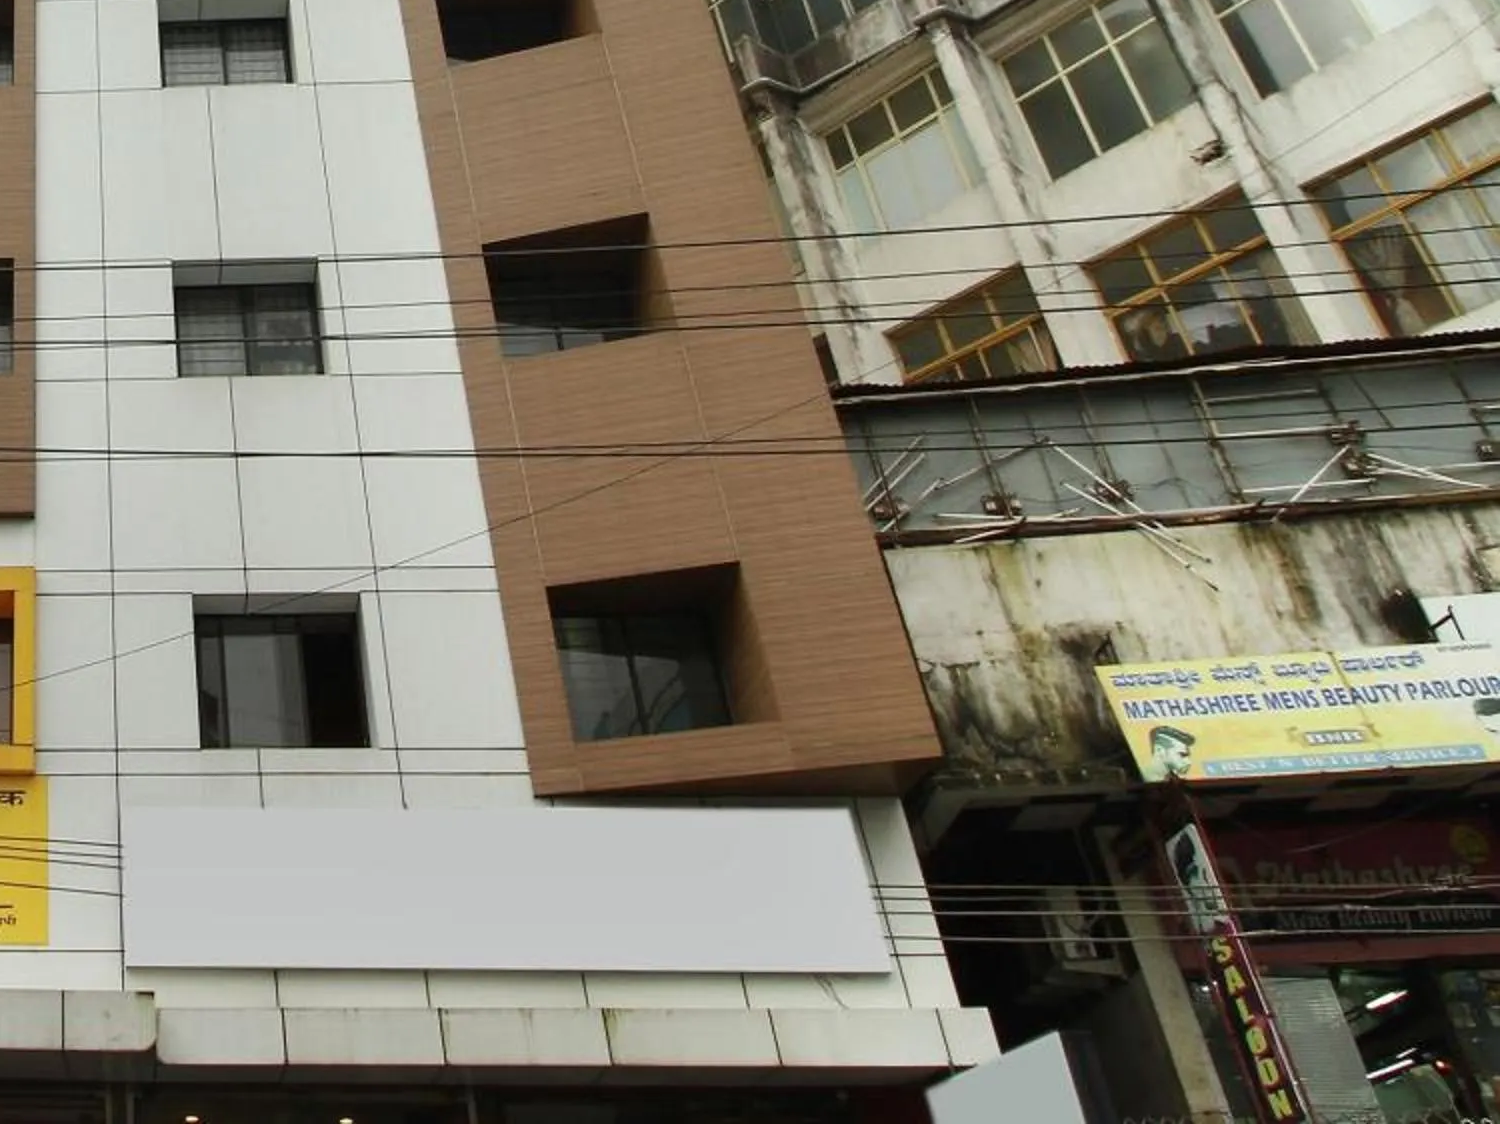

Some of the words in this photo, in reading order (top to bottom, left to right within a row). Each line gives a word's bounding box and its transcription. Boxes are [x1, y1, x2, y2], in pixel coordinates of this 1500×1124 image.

[1122, 693, 1261, 719] MATHASHREE
[1262, 689, 1320, 710] MENS
[1321, 682, 1400, 706] BEAUTY
[1403, 676, 1500, 701] PARLOUR
